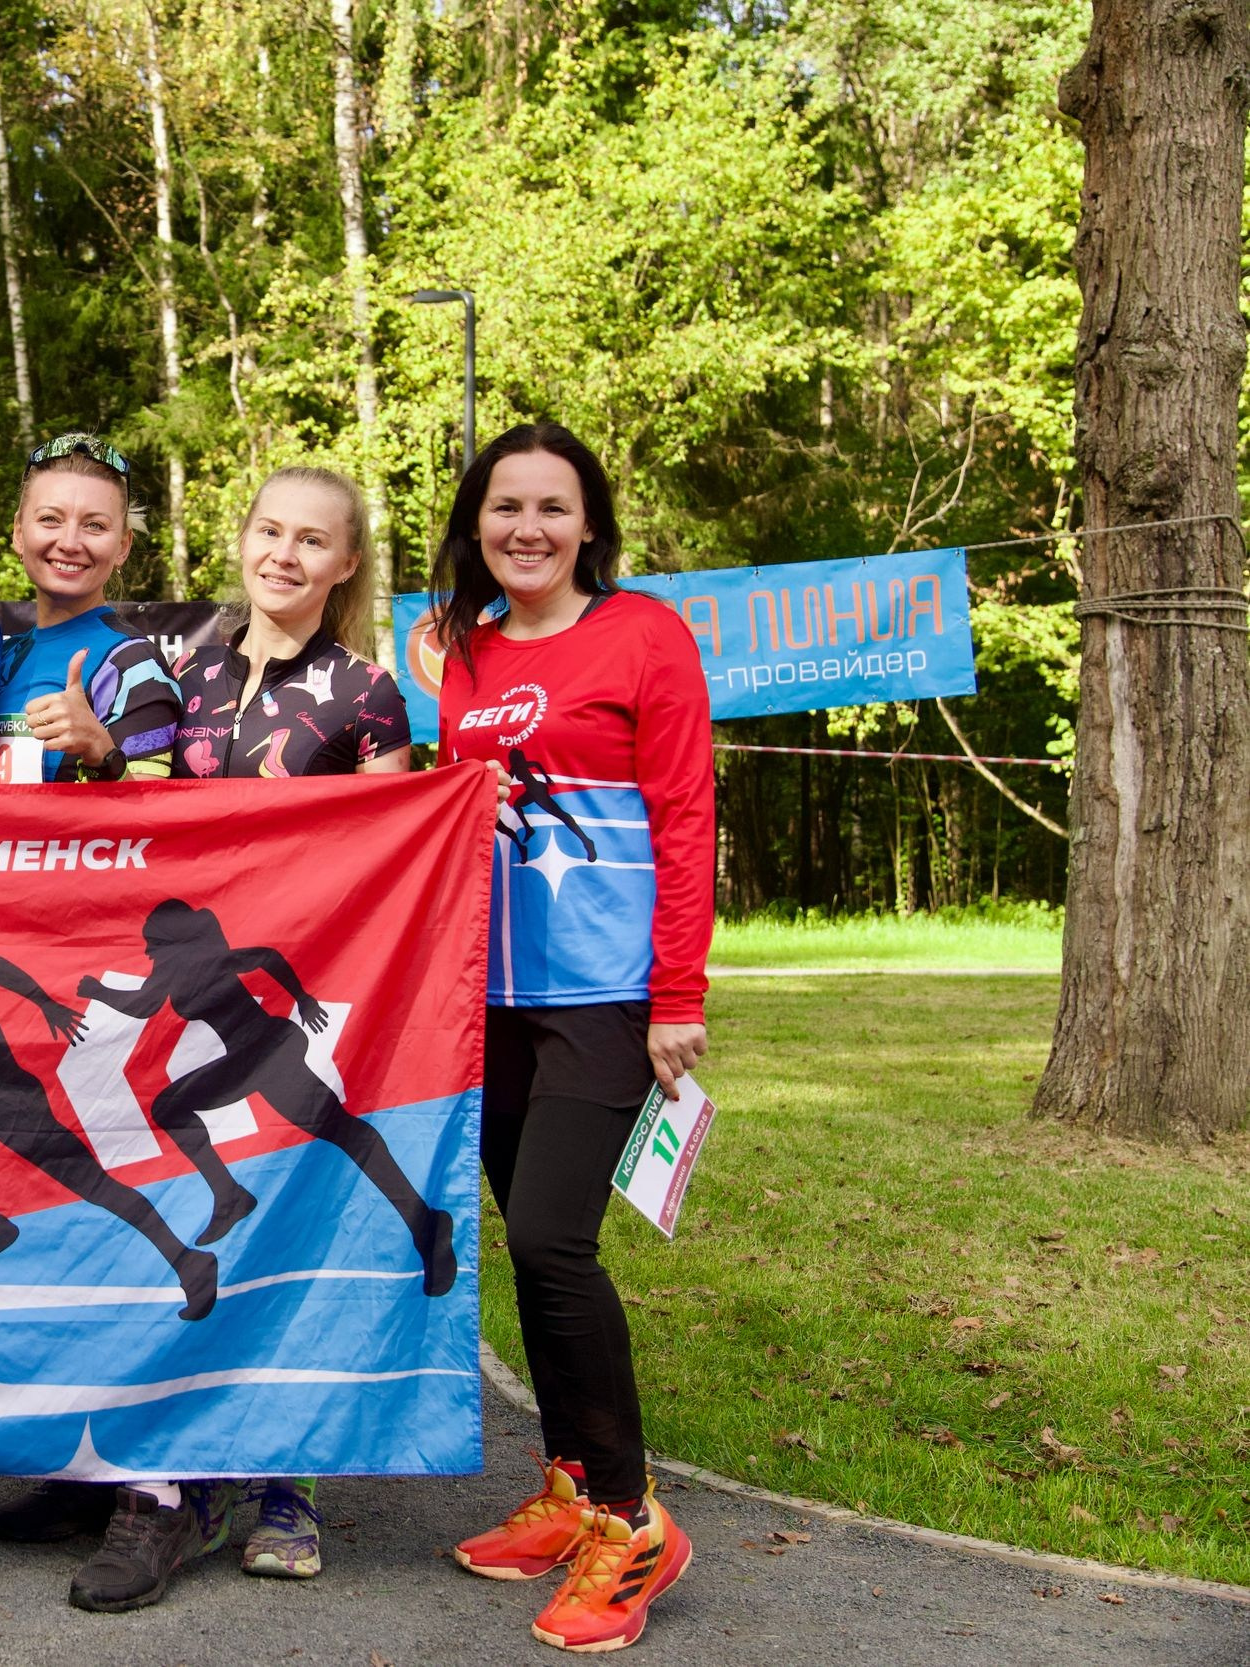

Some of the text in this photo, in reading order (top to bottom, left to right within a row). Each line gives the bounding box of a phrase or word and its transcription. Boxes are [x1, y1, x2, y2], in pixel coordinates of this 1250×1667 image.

[749, 574, 943, 653] ЛИНИЯ
[458, 701, 535, 731] БЕГИ
[497, 683, 548, 746] КРАСНОЗНАМЕНСК
[622, 1087, 664, 1177] КРОСС ДУБ
[652, 1117, 681, 1166] 17
[686, 1115, 708, 1158] 14.09.25
